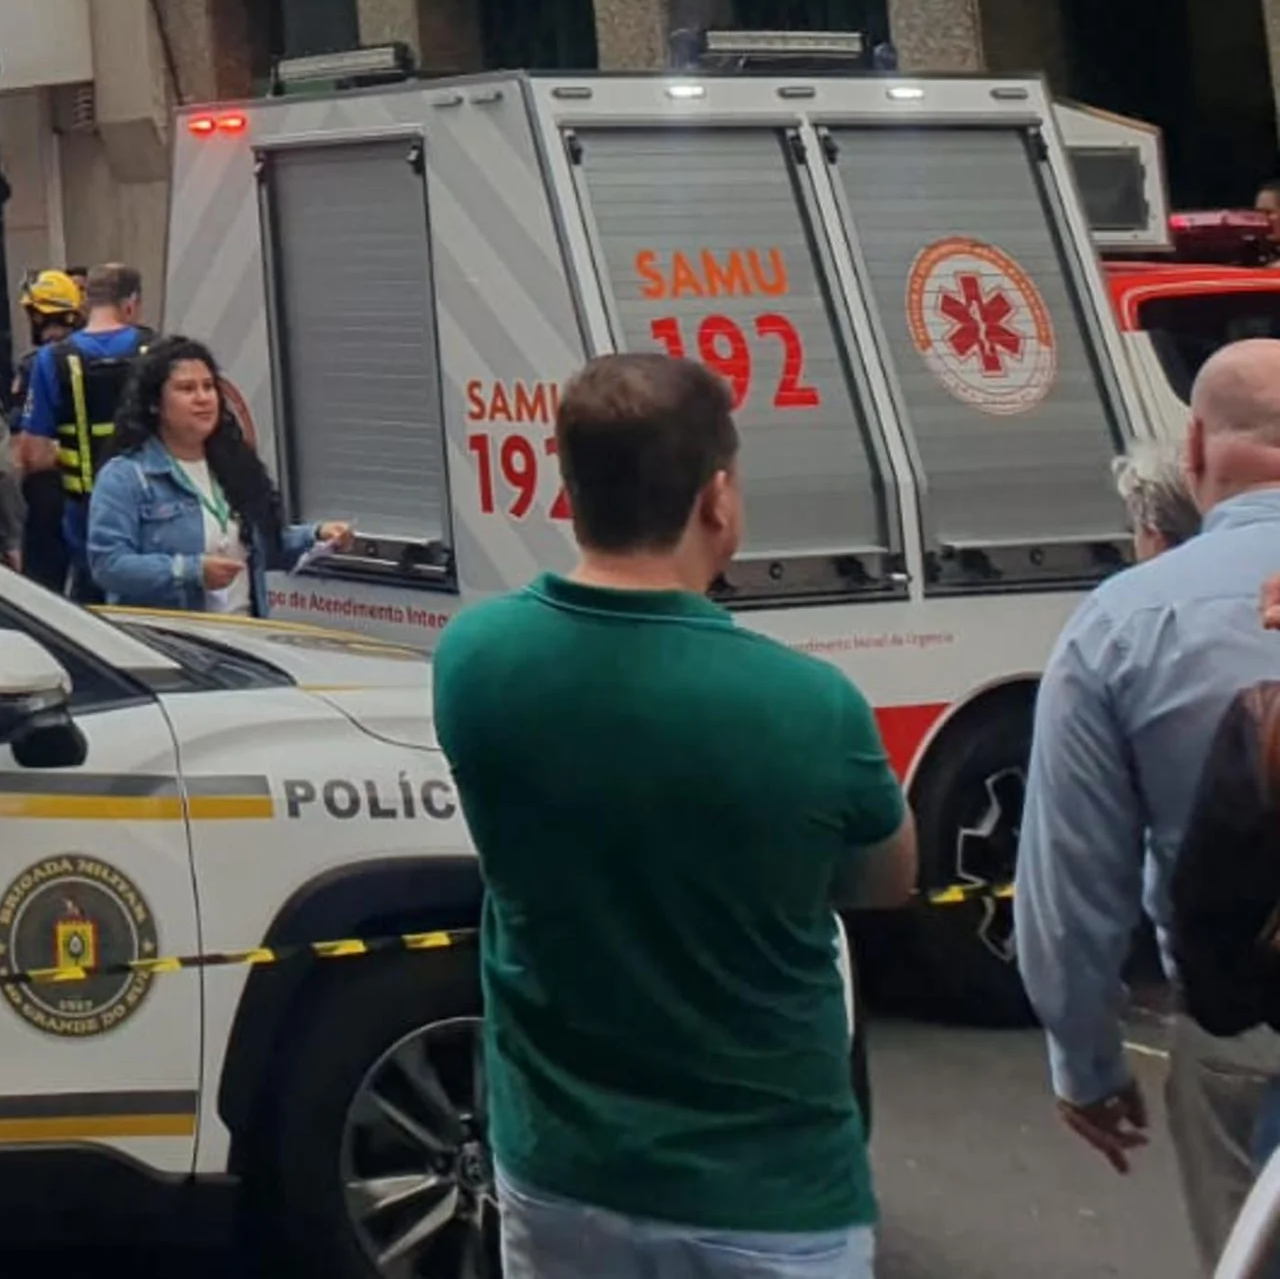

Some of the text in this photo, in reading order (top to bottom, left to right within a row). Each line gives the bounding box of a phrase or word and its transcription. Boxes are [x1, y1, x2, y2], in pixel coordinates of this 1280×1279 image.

[634, 246, 789, 300] SAMU
[289, 592, 307, 609] de
[309, 592, 403, 623] Atendimento
[284, 770, 456, 819] POLÍC
[0, 858, 73, 925] BRIGADA
